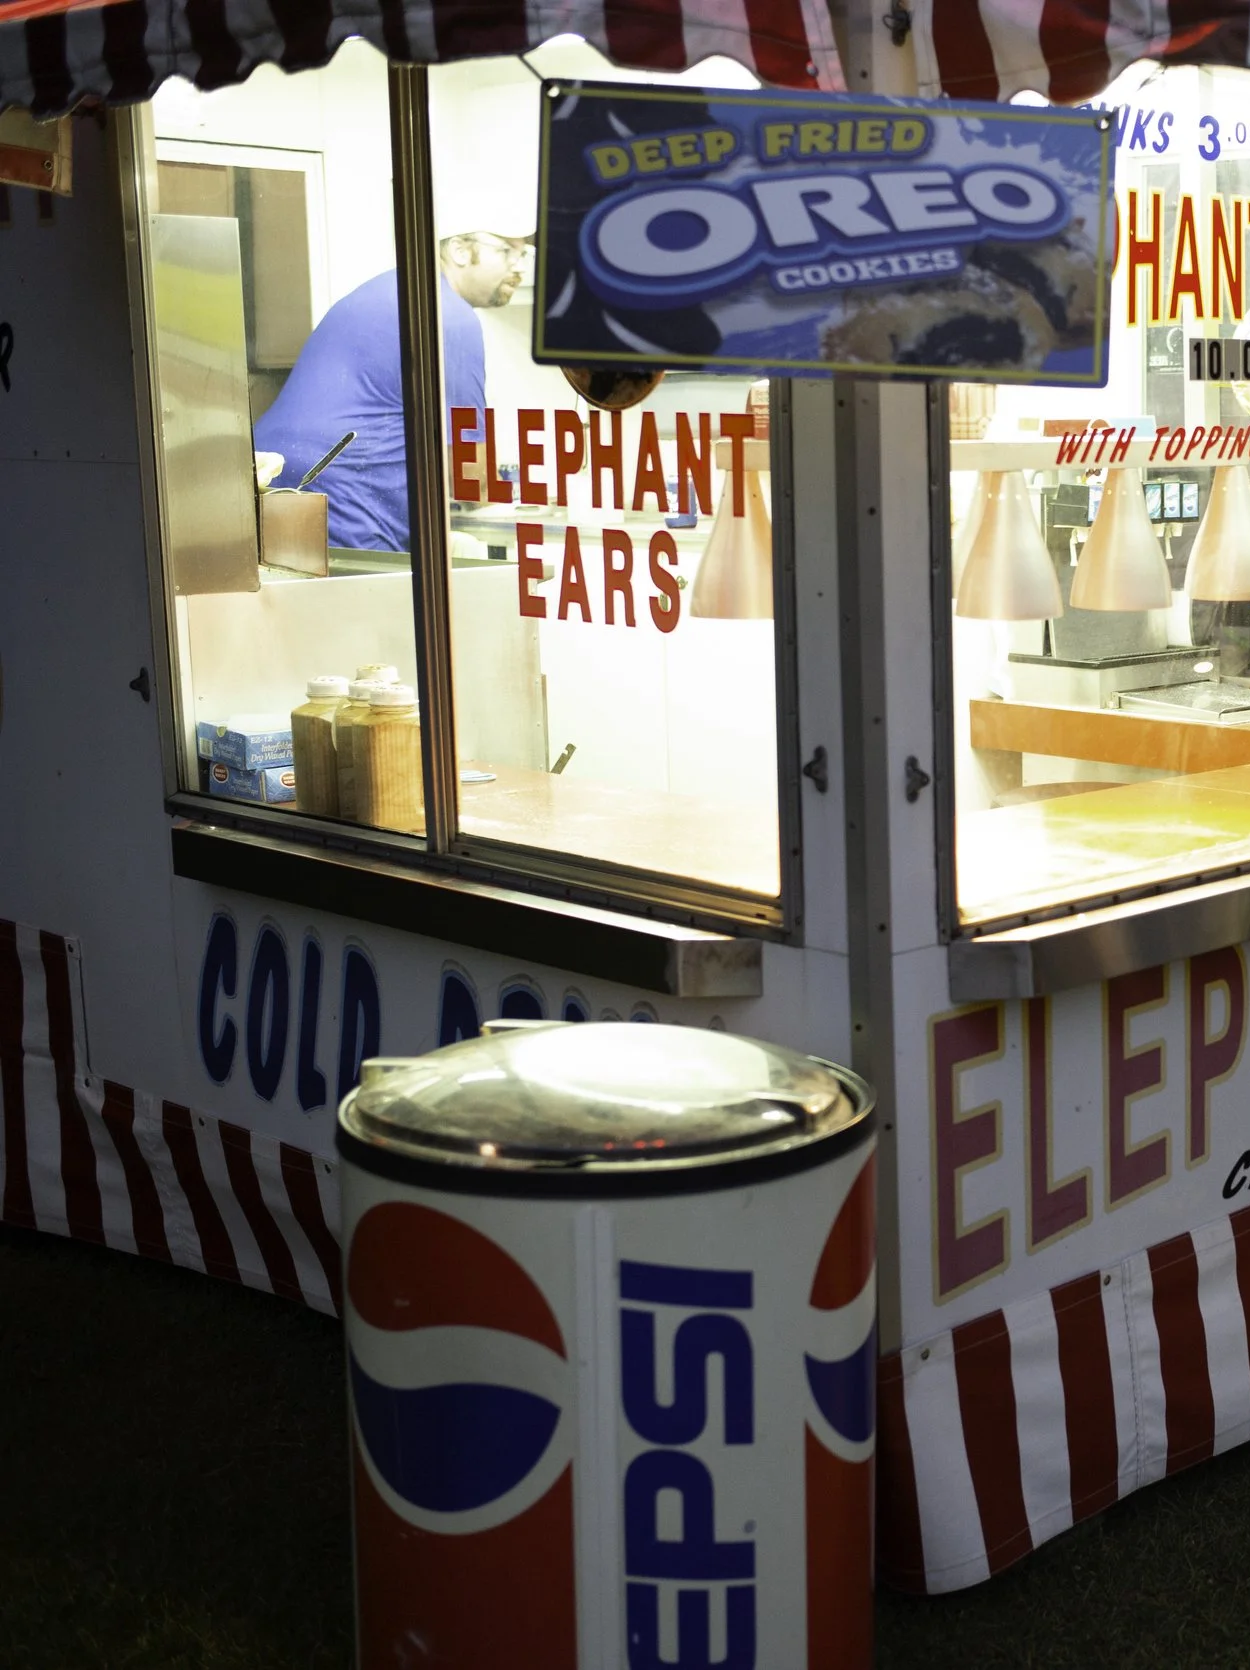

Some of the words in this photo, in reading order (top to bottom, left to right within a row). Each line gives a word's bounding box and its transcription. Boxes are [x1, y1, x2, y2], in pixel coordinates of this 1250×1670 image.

[591, 129, 736, 179] DEEP
[763, 119, 927, 159] FRIED
[597, 169, 1058, 278] OREO
[776, 248, 960, 291] COOKIES
[450, 407, 755, 518] ELEPHANT
[1056, 426, 1137, 465] WITH
[516, 522, 681, 633] EARS
[198, 908, 382, 1112] COLD
[617, 1258, 758, 1670] EPSI
